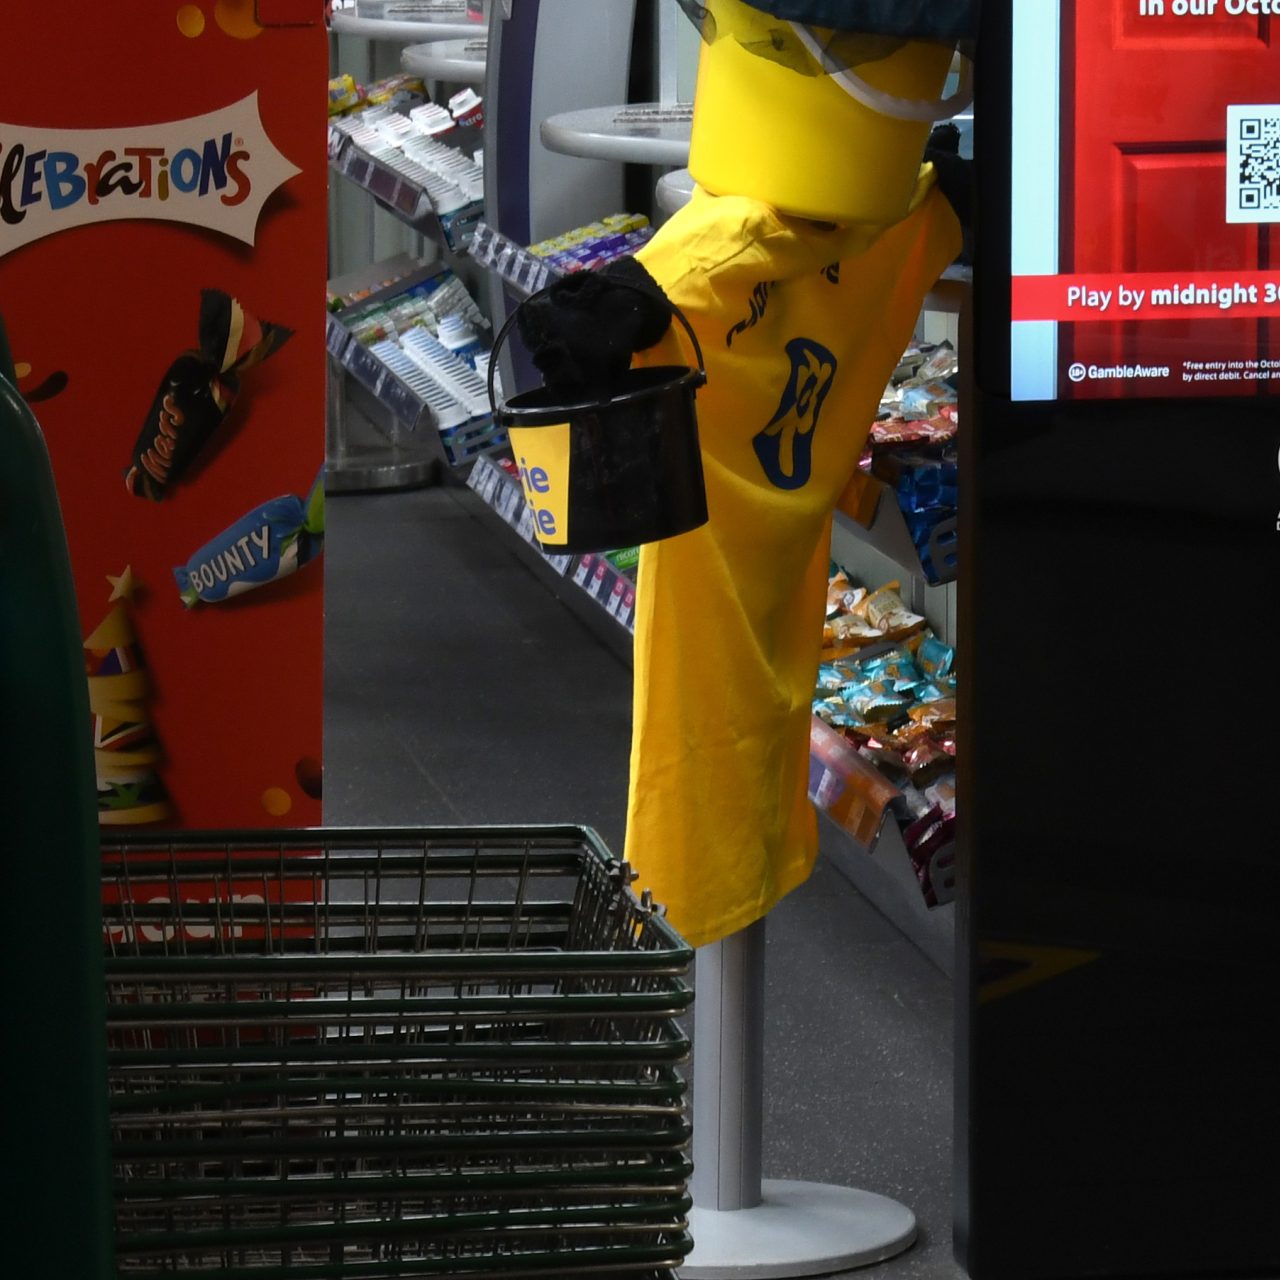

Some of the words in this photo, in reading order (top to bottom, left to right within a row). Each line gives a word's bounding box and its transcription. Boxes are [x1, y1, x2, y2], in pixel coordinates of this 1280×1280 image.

[1068, 285, 1112, 310] Play
[1118, 285, 1145, 310] by
[1151, 283, 1257, 309] midnight
[1088, 364, 1170, 379] GambleAware
[1182, 372, 1193, 382] by
[1194, 371, 1217, 380] direct
[1219, 371, 1242, 380] debit.
[1243, 370, 1270, 380] Cancel
[1205, 361, 1226, 371] entry
[1227, 360, 1244, 369] into
[1245, 360, 1259, 369] the
[140, 394, 184, 484] Mars
[188, 525, 270, 593] BOUNTY
